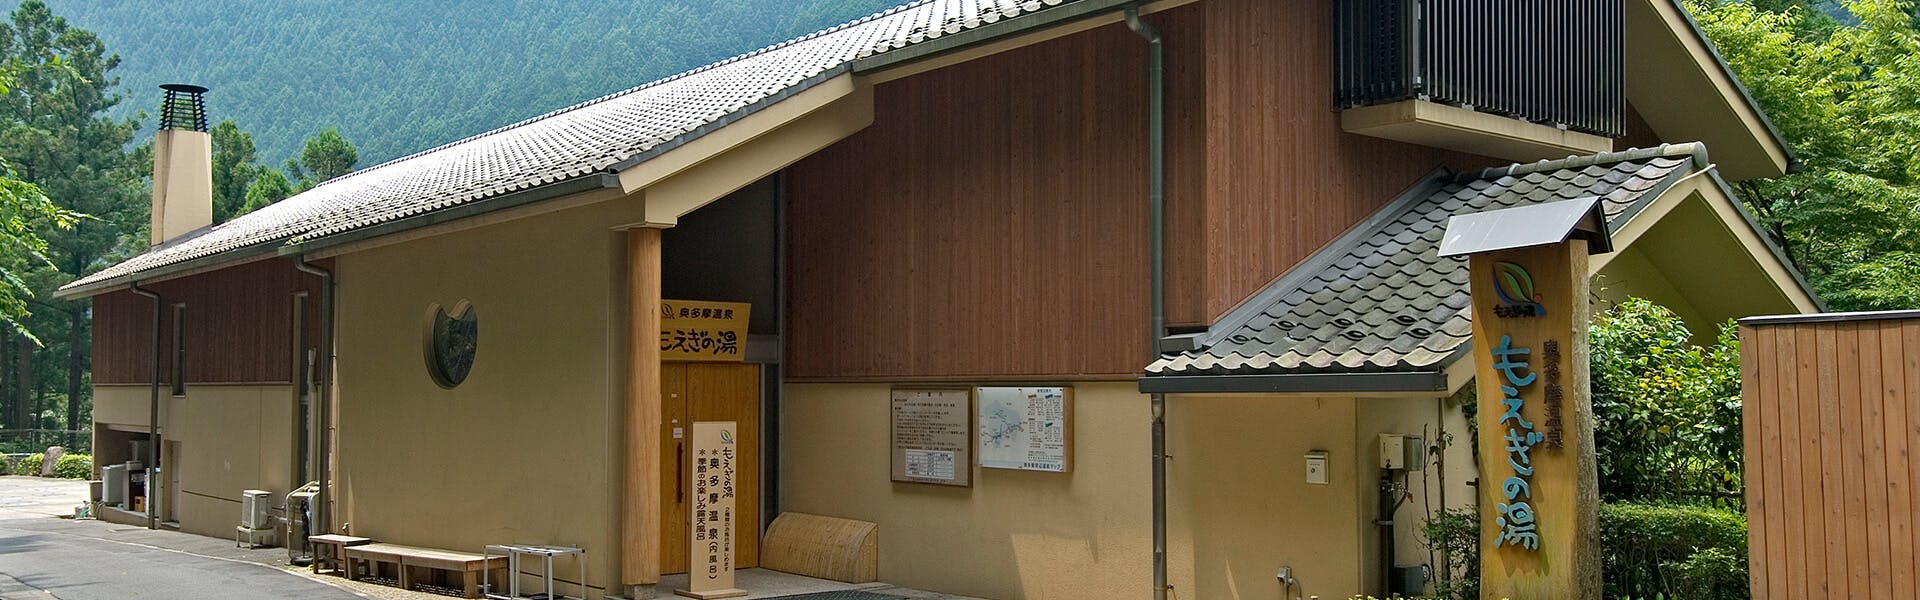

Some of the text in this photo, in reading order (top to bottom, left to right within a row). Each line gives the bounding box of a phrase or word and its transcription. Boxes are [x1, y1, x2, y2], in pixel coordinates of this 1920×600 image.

[679, 307, 734, 320] 奥多摩温泉
[1543, 339, 1563, 450] 奥多摩温泉
[722, 447, 734, 498] もえぎの湯
[1490, 335, 1545, 551] もえぎの湯
